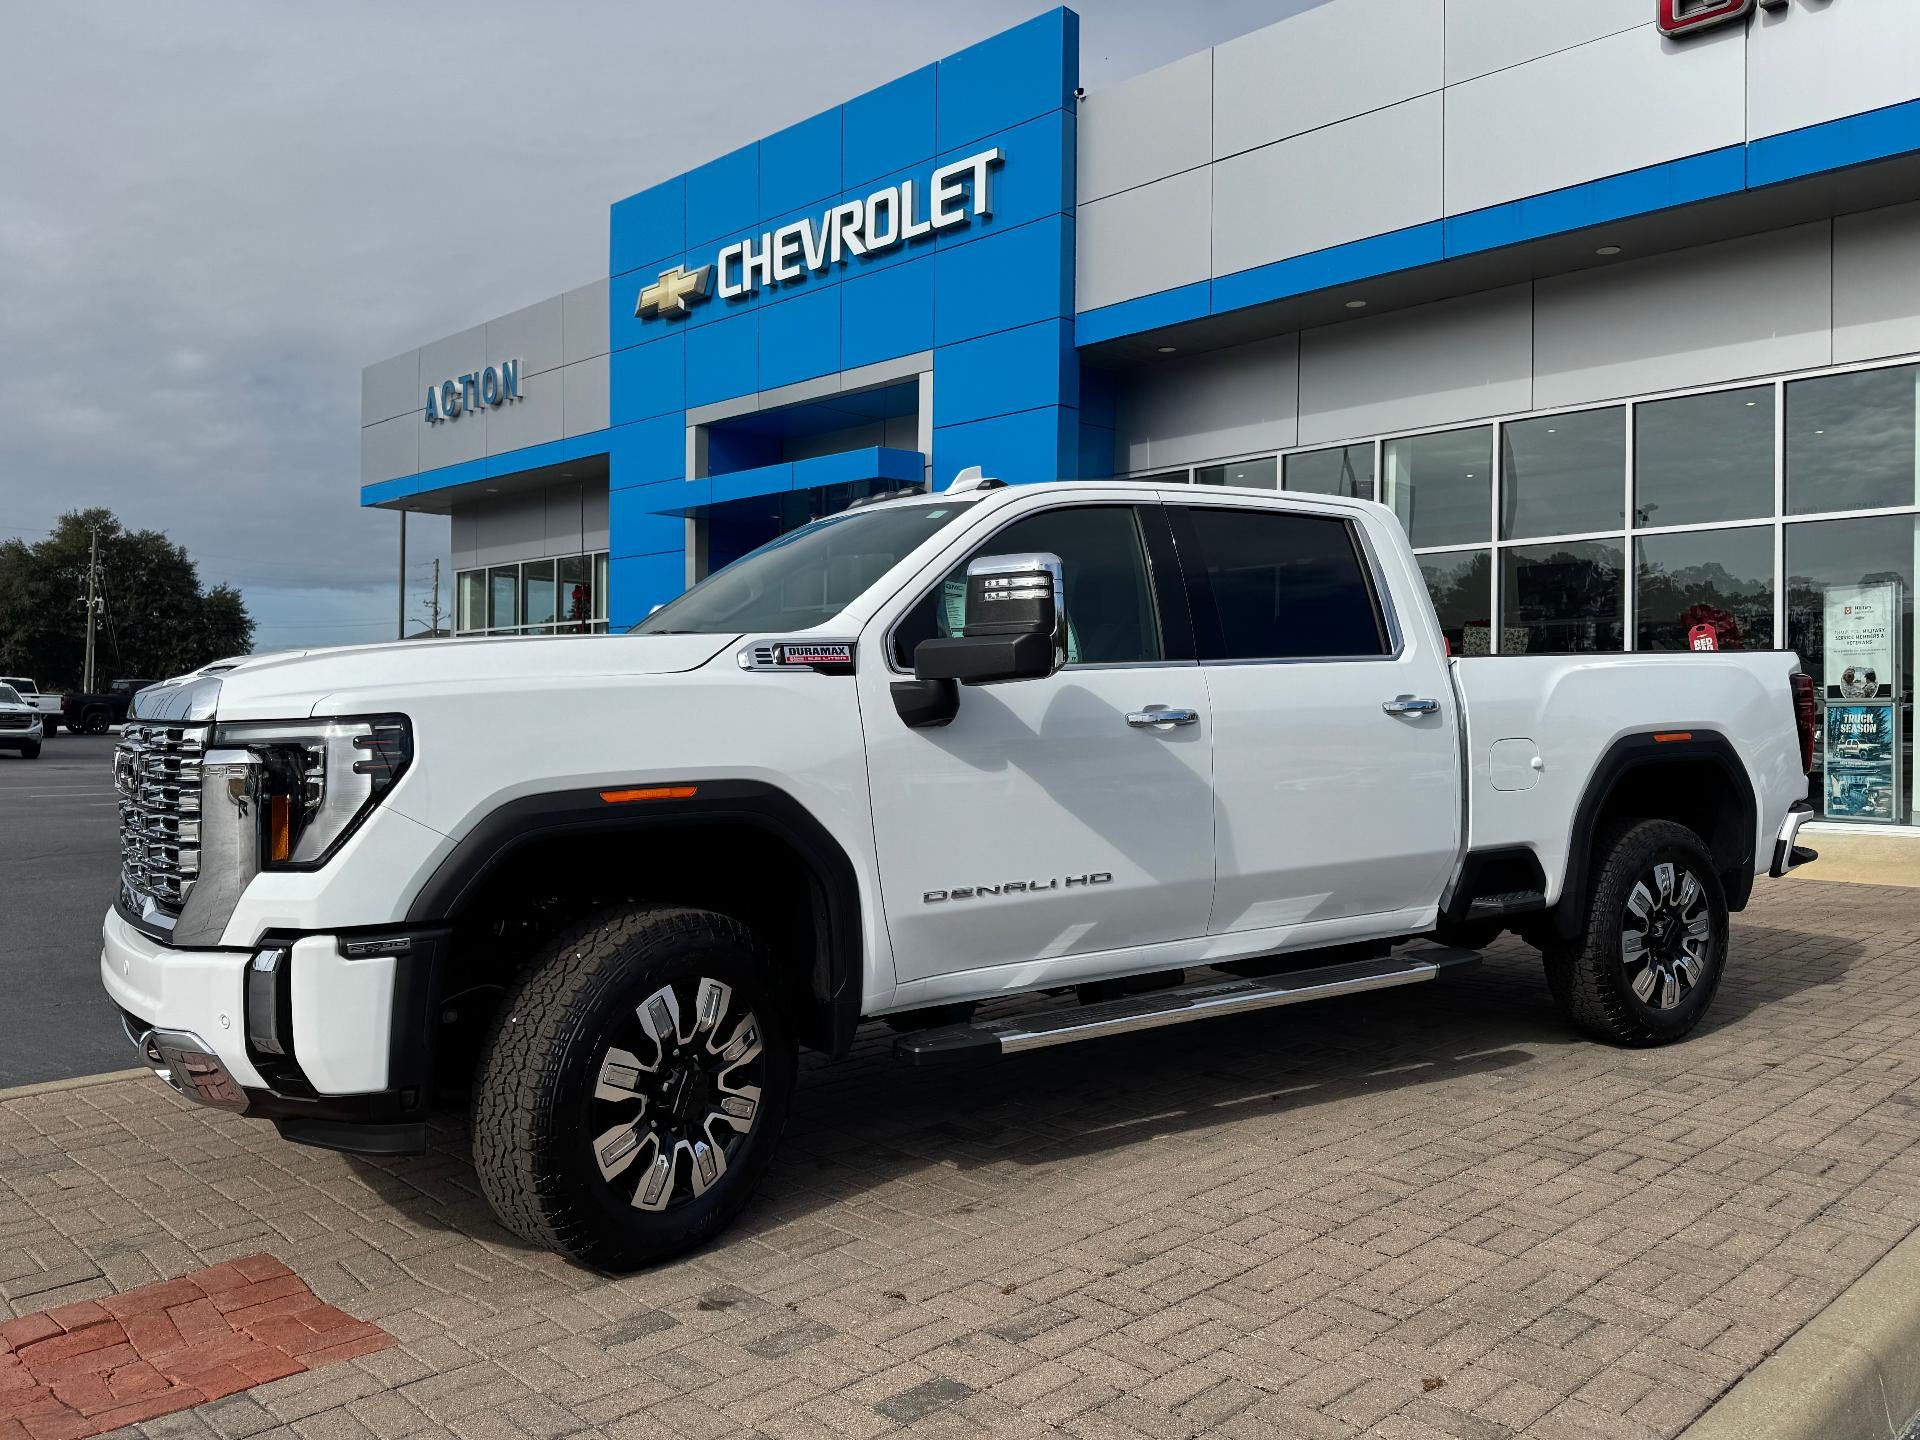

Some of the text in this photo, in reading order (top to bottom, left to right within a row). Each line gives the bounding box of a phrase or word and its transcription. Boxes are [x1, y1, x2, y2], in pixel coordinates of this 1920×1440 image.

[717, 147, 1003, 299] CHEVROLET
[425, 359, 523, 423] ACTION
[1694, 637, 1713, 647] RED
[788, 647, 847, 656] DURAMAX
[1843, 713, 1874, 724] TRUCK
[1840, 723, 1877, 734] SEASON
[923, 872, 1112, 903] DENALI HD
